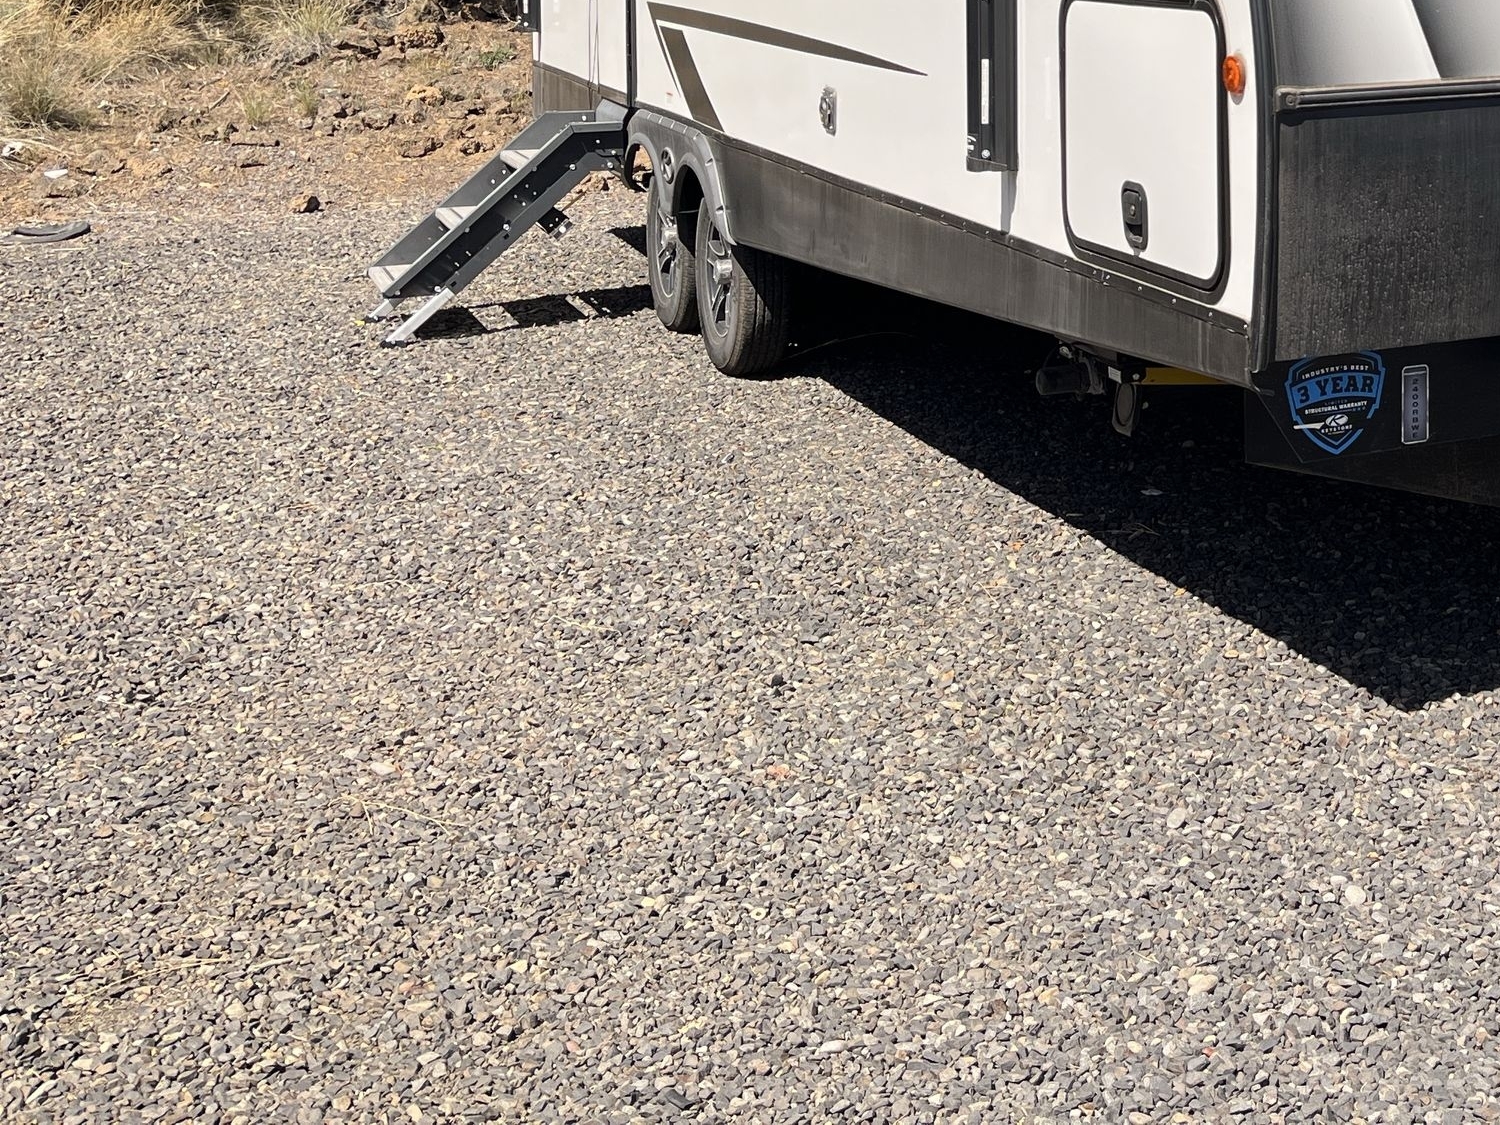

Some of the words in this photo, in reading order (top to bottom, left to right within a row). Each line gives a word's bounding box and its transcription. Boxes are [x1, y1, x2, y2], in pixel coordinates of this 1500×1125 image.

[1301, 365, 1348, 380] INDUSTRY'S
[1297, 386, 1310, 404] 3
[1315, 375, 1375, 396] YEAR
[1304, 405, 1338, 415] STRUCTURAL
[1339, 400, 1368, 410] WARRANTY
